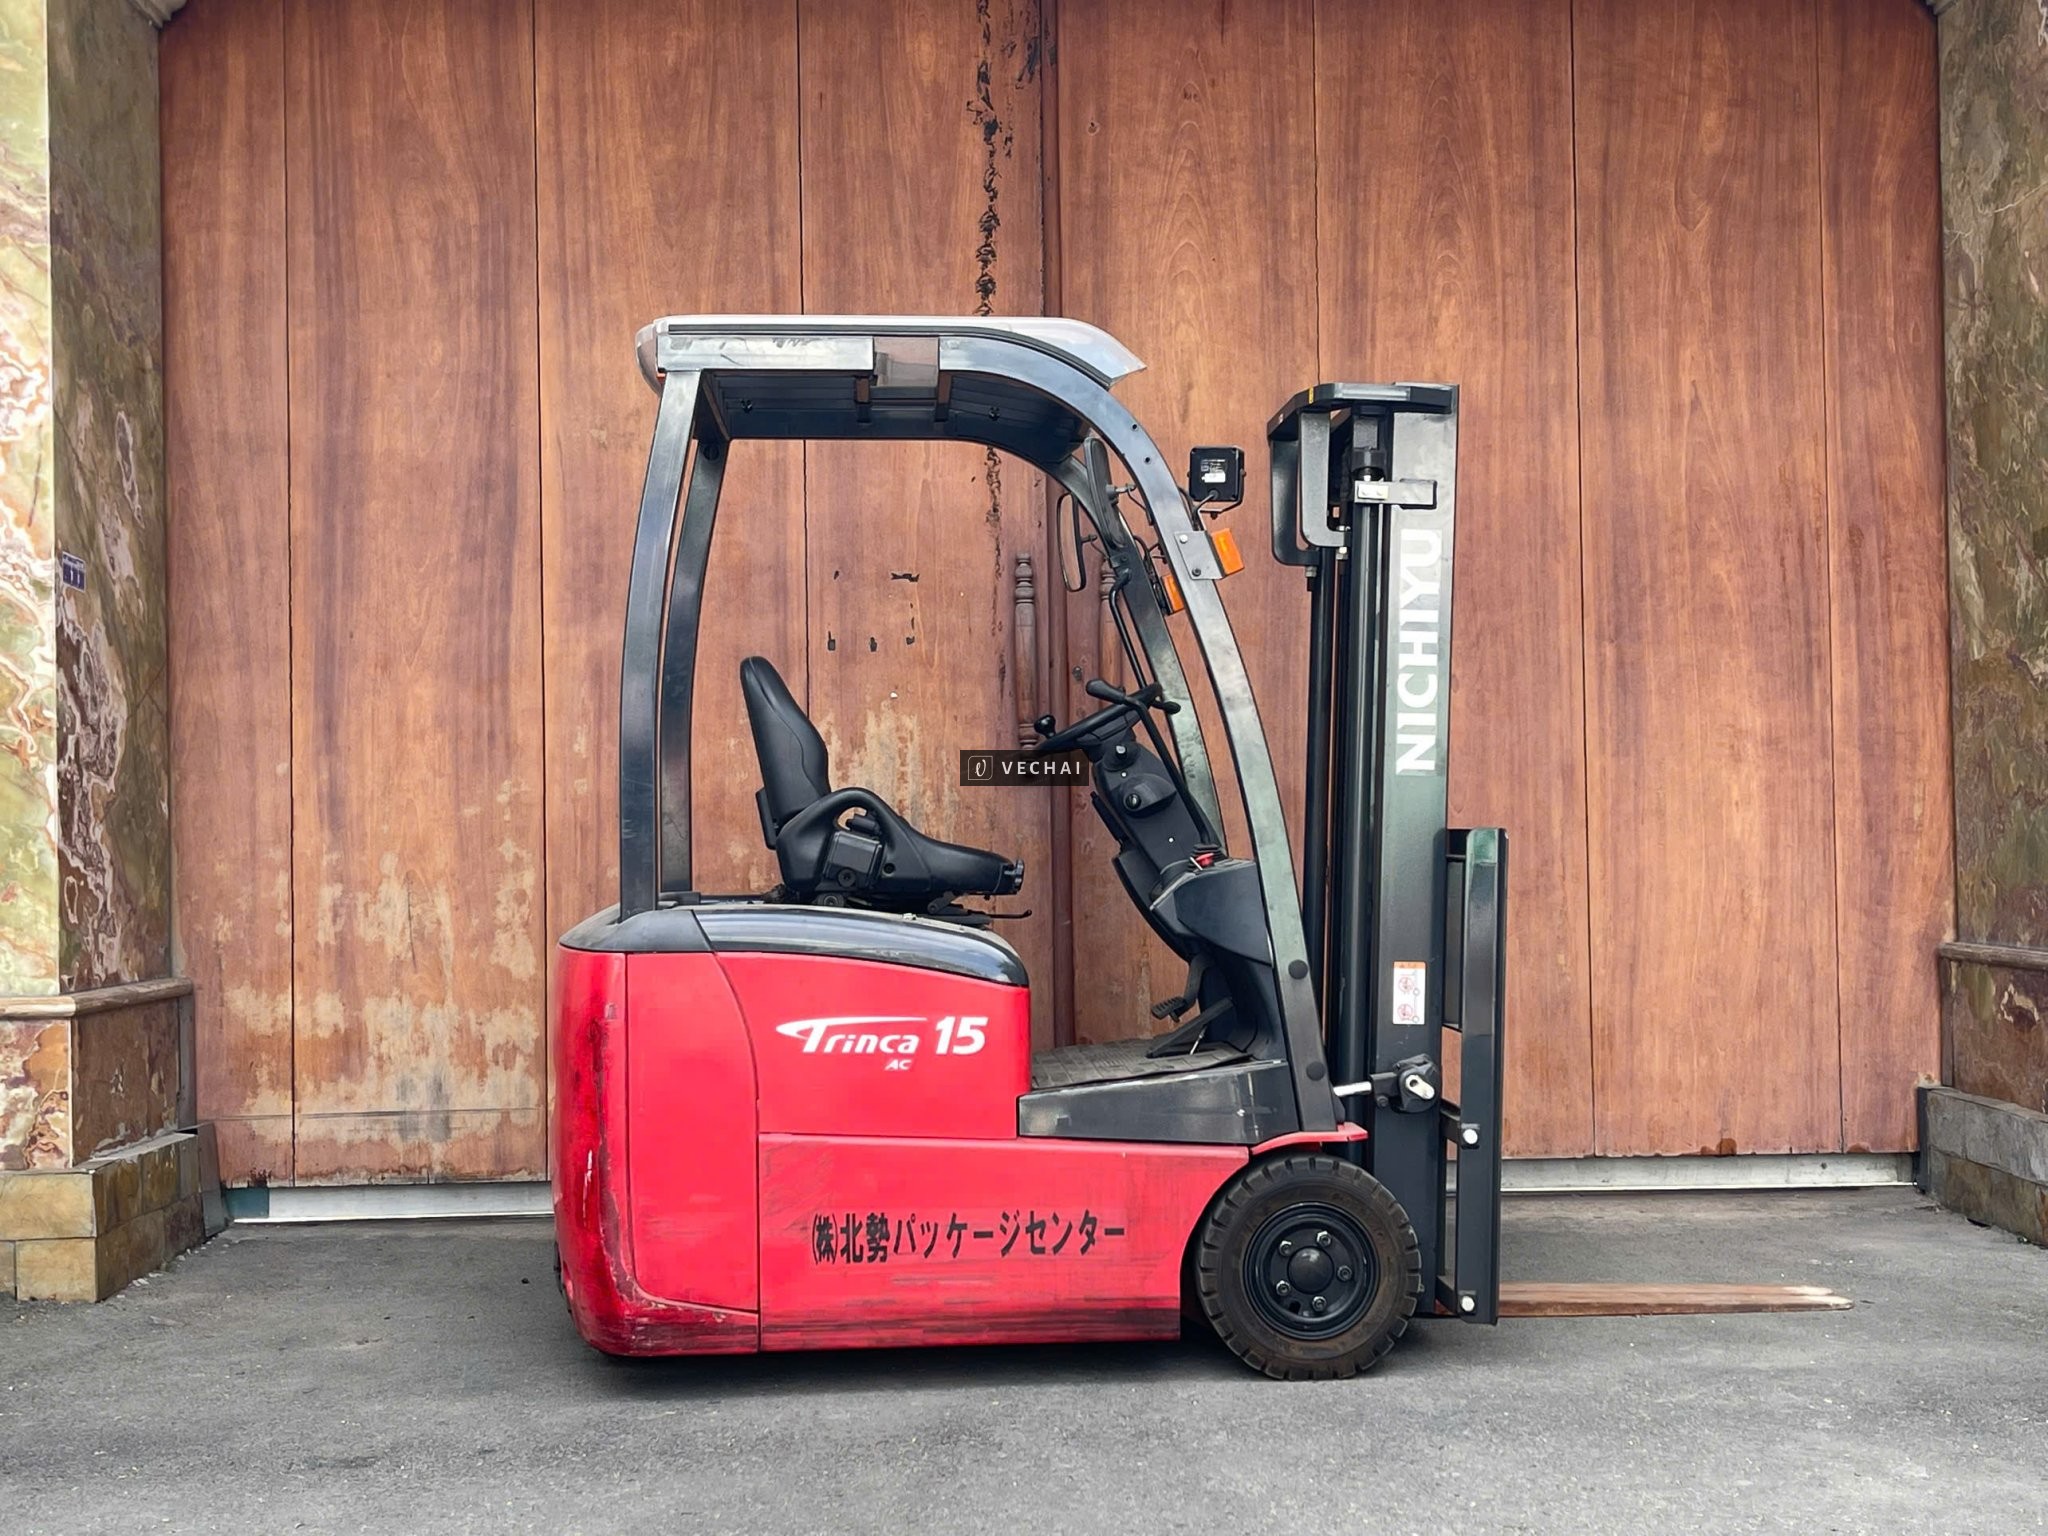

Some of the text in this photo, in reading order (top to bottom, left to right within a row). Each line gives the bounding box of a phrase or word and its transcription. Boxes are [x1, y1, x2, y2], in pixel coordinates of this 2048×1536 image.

[1396, 528, 1442, 775] NICHIYU
[776, 1016, 988, 1055] Trinca 15
[884, 1059, 912, 1071] AC
